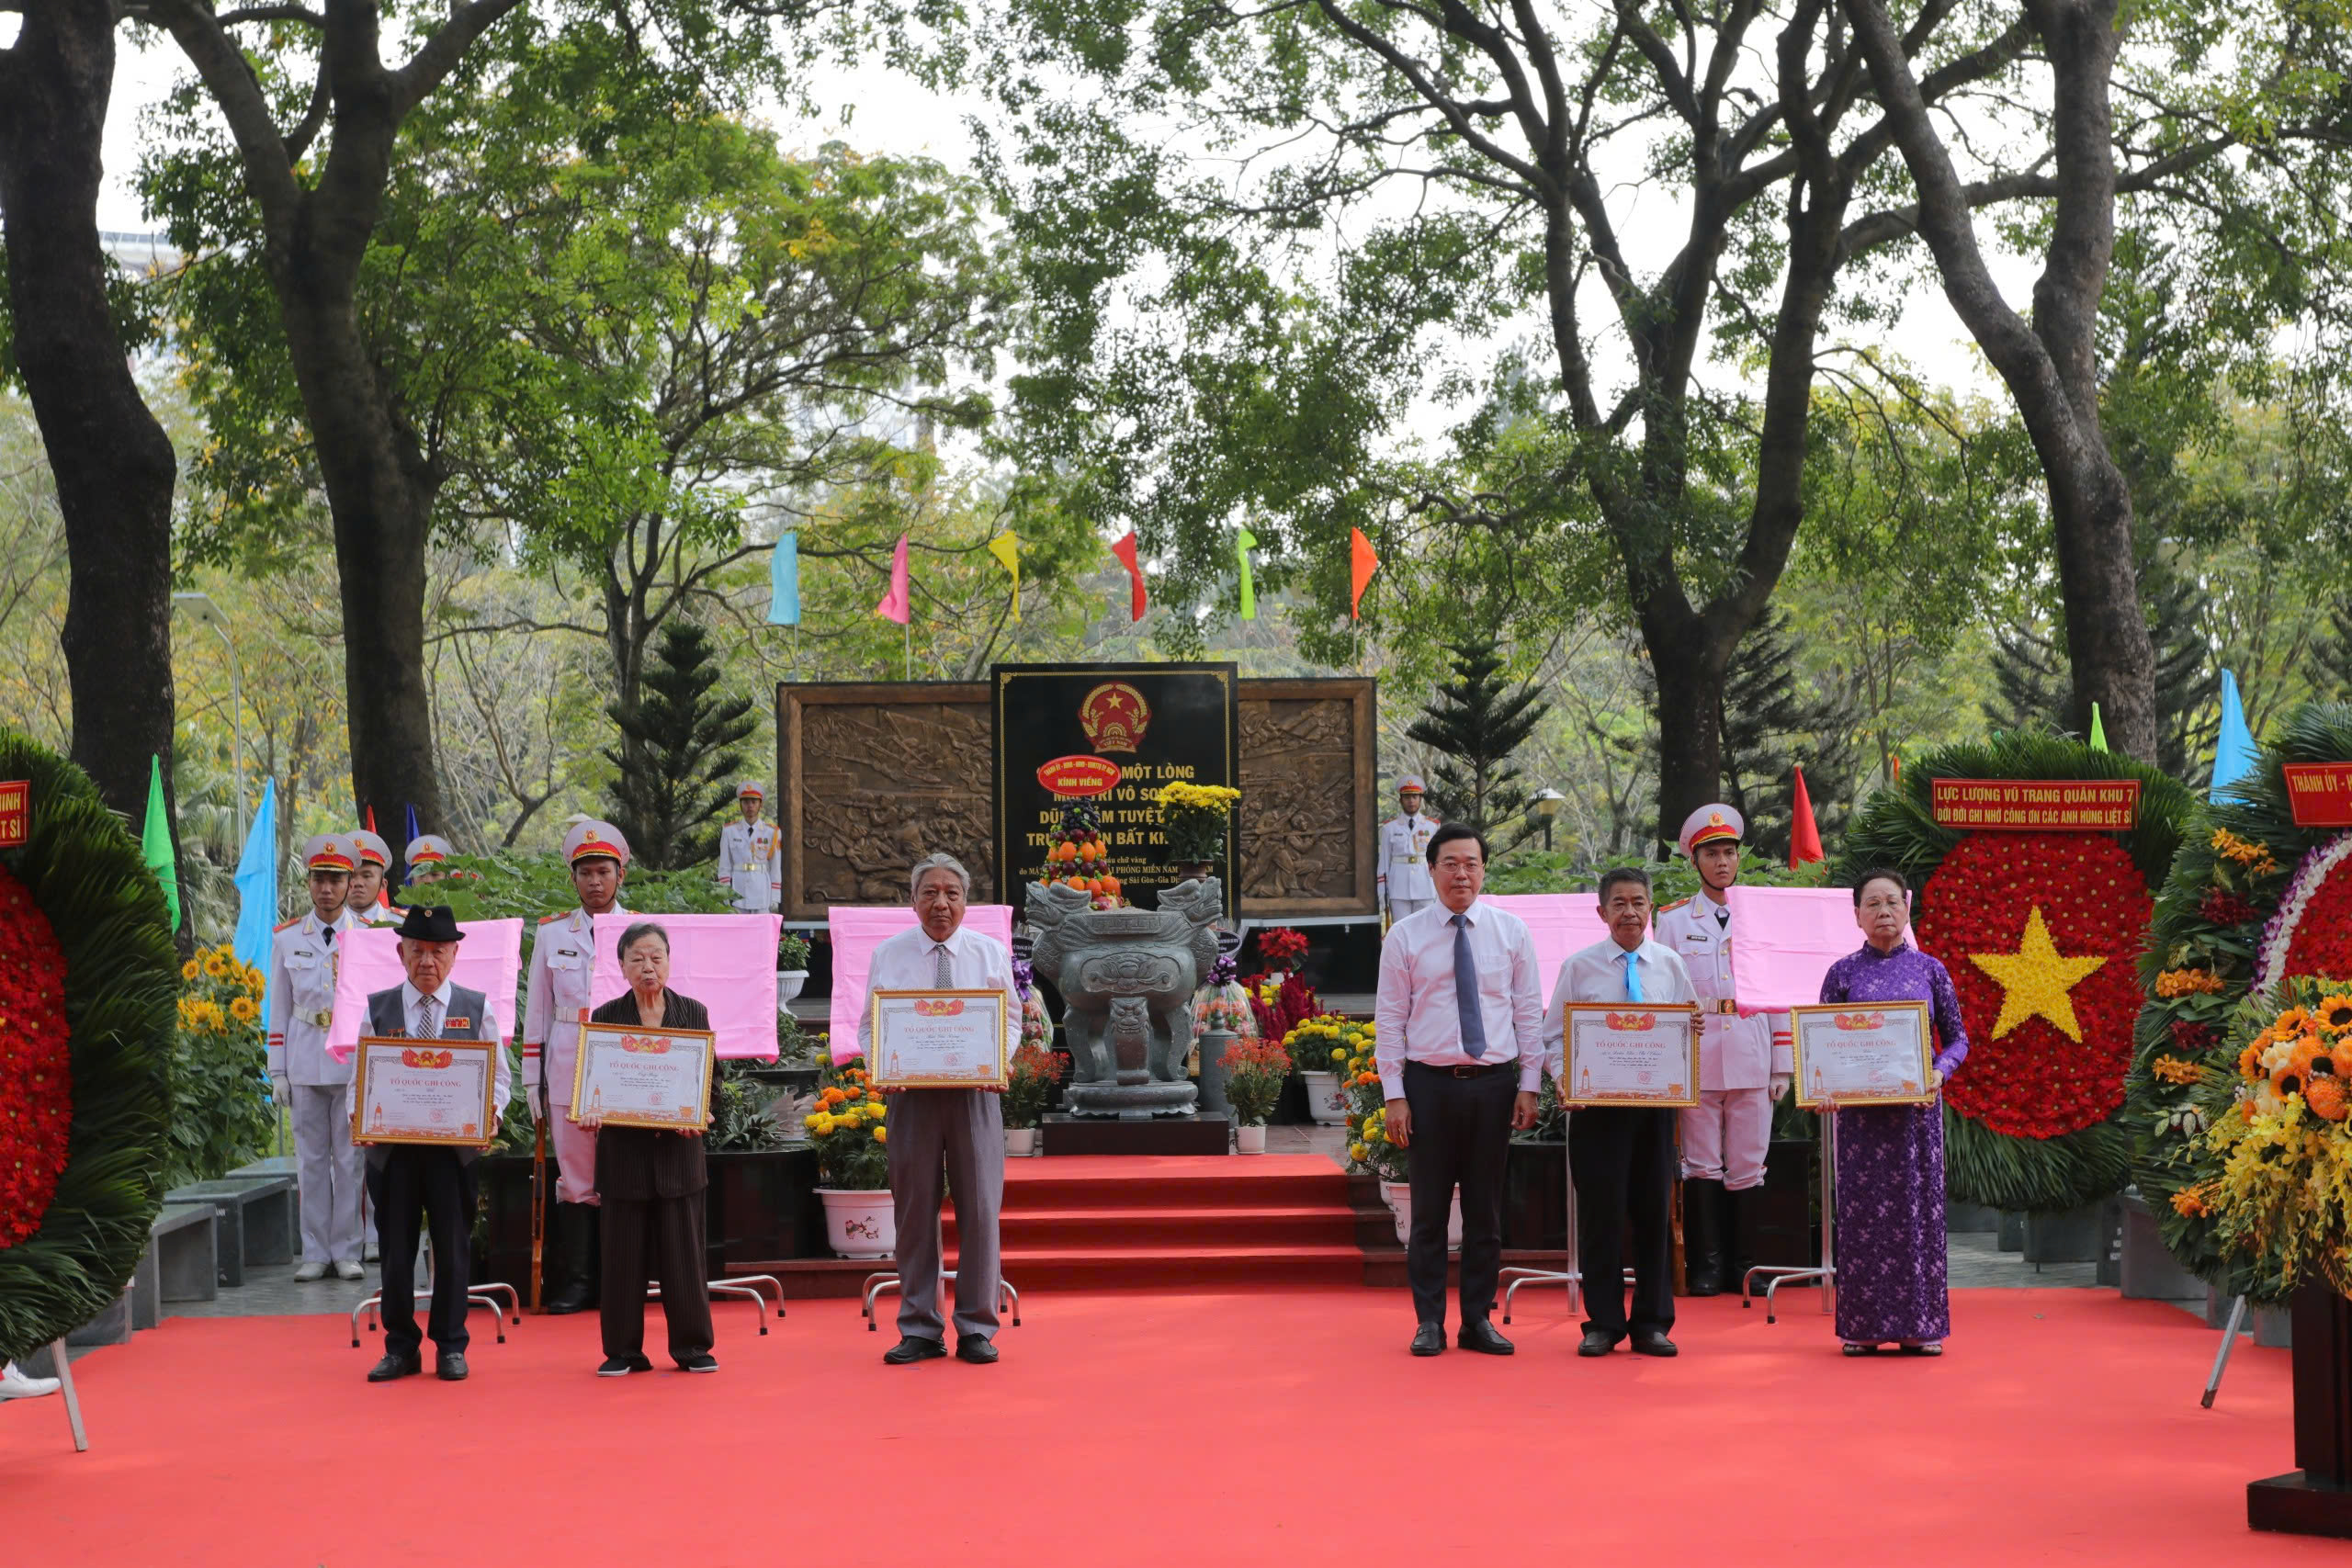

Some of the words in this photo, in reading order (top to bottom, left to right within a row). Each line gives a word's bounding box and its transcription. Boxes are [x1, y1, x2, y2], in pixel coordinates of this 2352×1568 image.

[1121, 762, 1152, 782] MỘT
[1157, 762, 1194, 779] LÒNG
[1057, 777, 1077, 787] KÍNH
[1080, 776, 1102, 787] VIẾNG
[2291, 772, 2324, 793] THÀNH
[1116, 785, 1136, 801] VÔ
[1937, 786, 1959, 804] LỰC
[1962, 786, 2001, 805] LƯỢNG
[2004, 786, 2019, 802] VŨ
[2022, 788, 2061, 803] TRANG
[2064, 786, 2096, 804] QUÂN
[2099, 788, 2123, 803] KHU
[2126, 789, 2134, 803] 7
[0, 793, 21, 812] INH
[1117, 807, 1164, 825] TUYỆT
[1969, 809, 1983, 823] GHI
[2004, 807, 2027, 824] CÔNG
[2041, 807, 2059, 824] CÁC
[2061, 809, 2078, 824] ANH
[2080, 807, 2103, 824] HÙNG
[2105, 807, 2122, 827] LIỆT
[1116, 828, 1145, 844] BẤT
[1130, 856, 1147, 864] vàng
[1142, 863, 1161, 874] MIỀN
[1162, 865, 1178, 874] NAM
[1129, 875, 1139, 884] Sài
